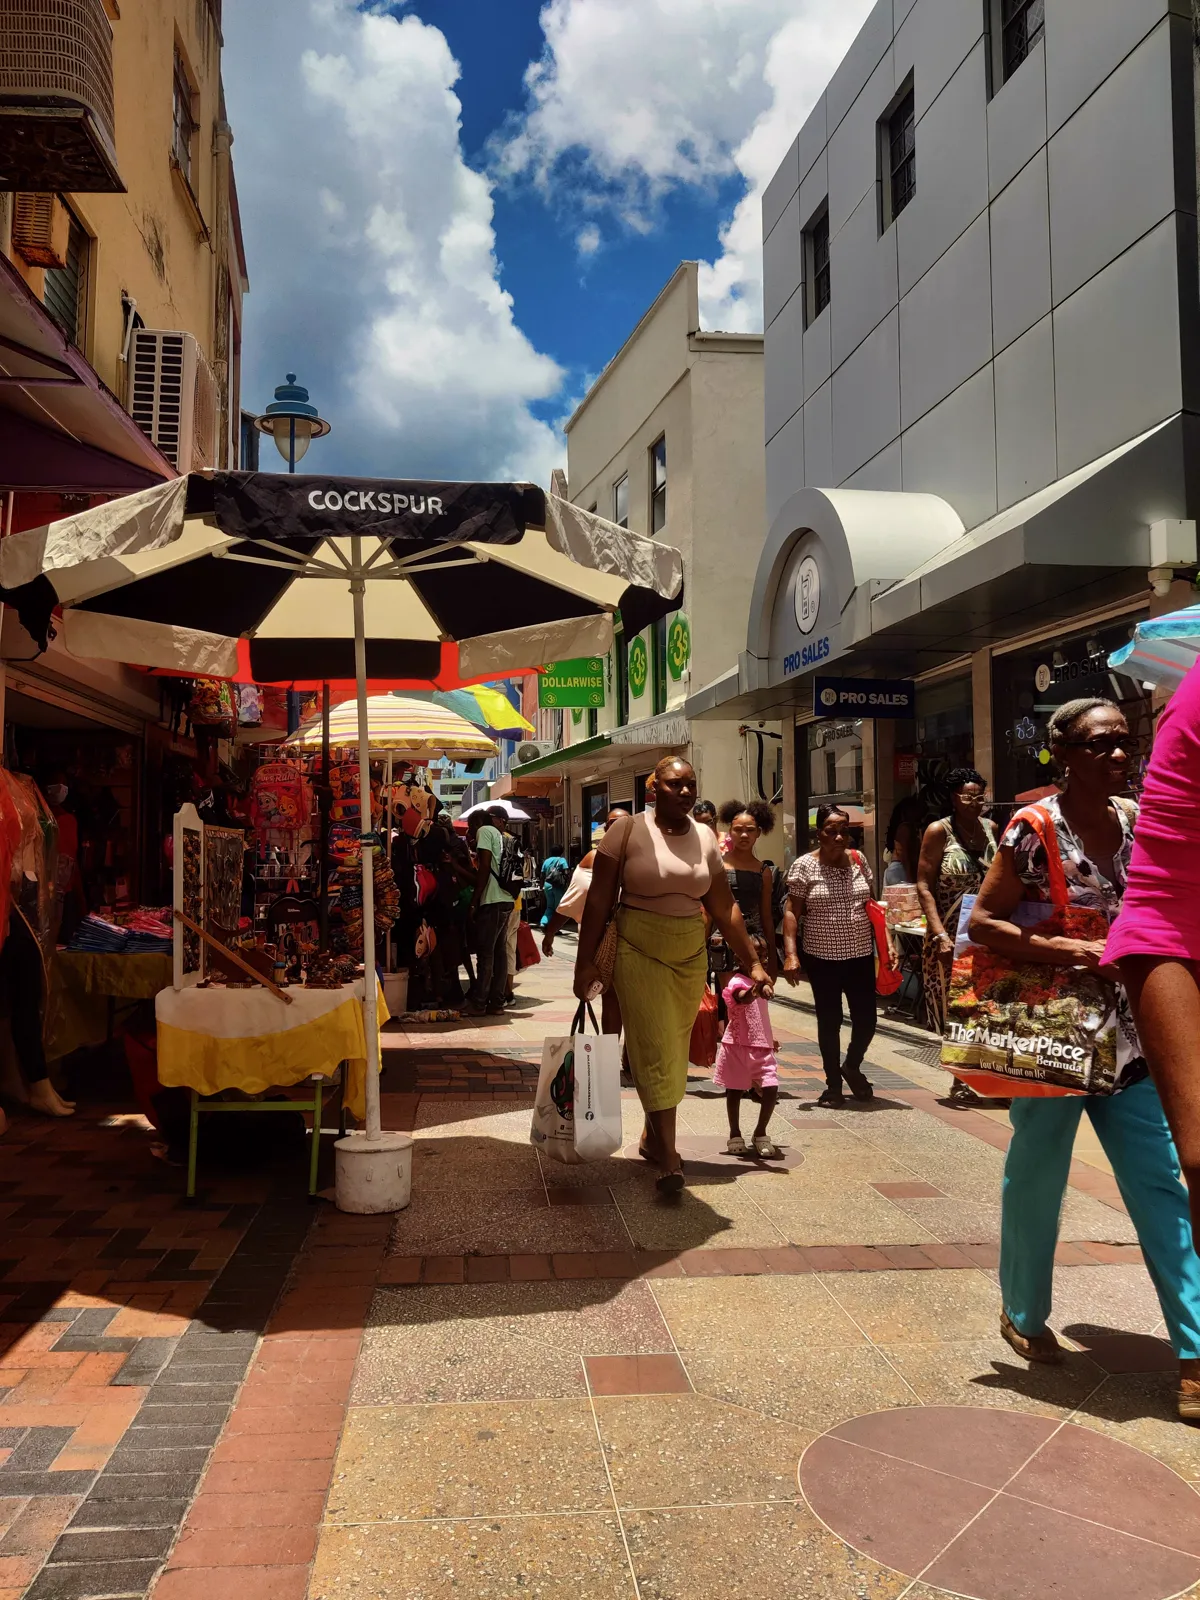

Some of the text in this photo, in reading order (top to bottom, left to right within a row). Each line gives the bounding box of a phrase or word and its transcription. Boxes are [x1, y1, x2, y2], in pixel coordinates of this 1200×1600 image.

[308, 490, 444, 516] COCKSPUR
[784, 637, 830, 675] PRO SALES
[1053, 661, 1078, 684] PRO
[839, 692, 909, 706] PRO SALES
[824, 725, 853, 742] PRO SALES
[980, 1058, 992, 1070] You
[992, 1061, 1004, 1073] Can
[1004, 1063, 1023, 1076] Count
[1024, 1069, 1034, 1078] on
[1036, 1055, 1082, 1073] Bermuda
